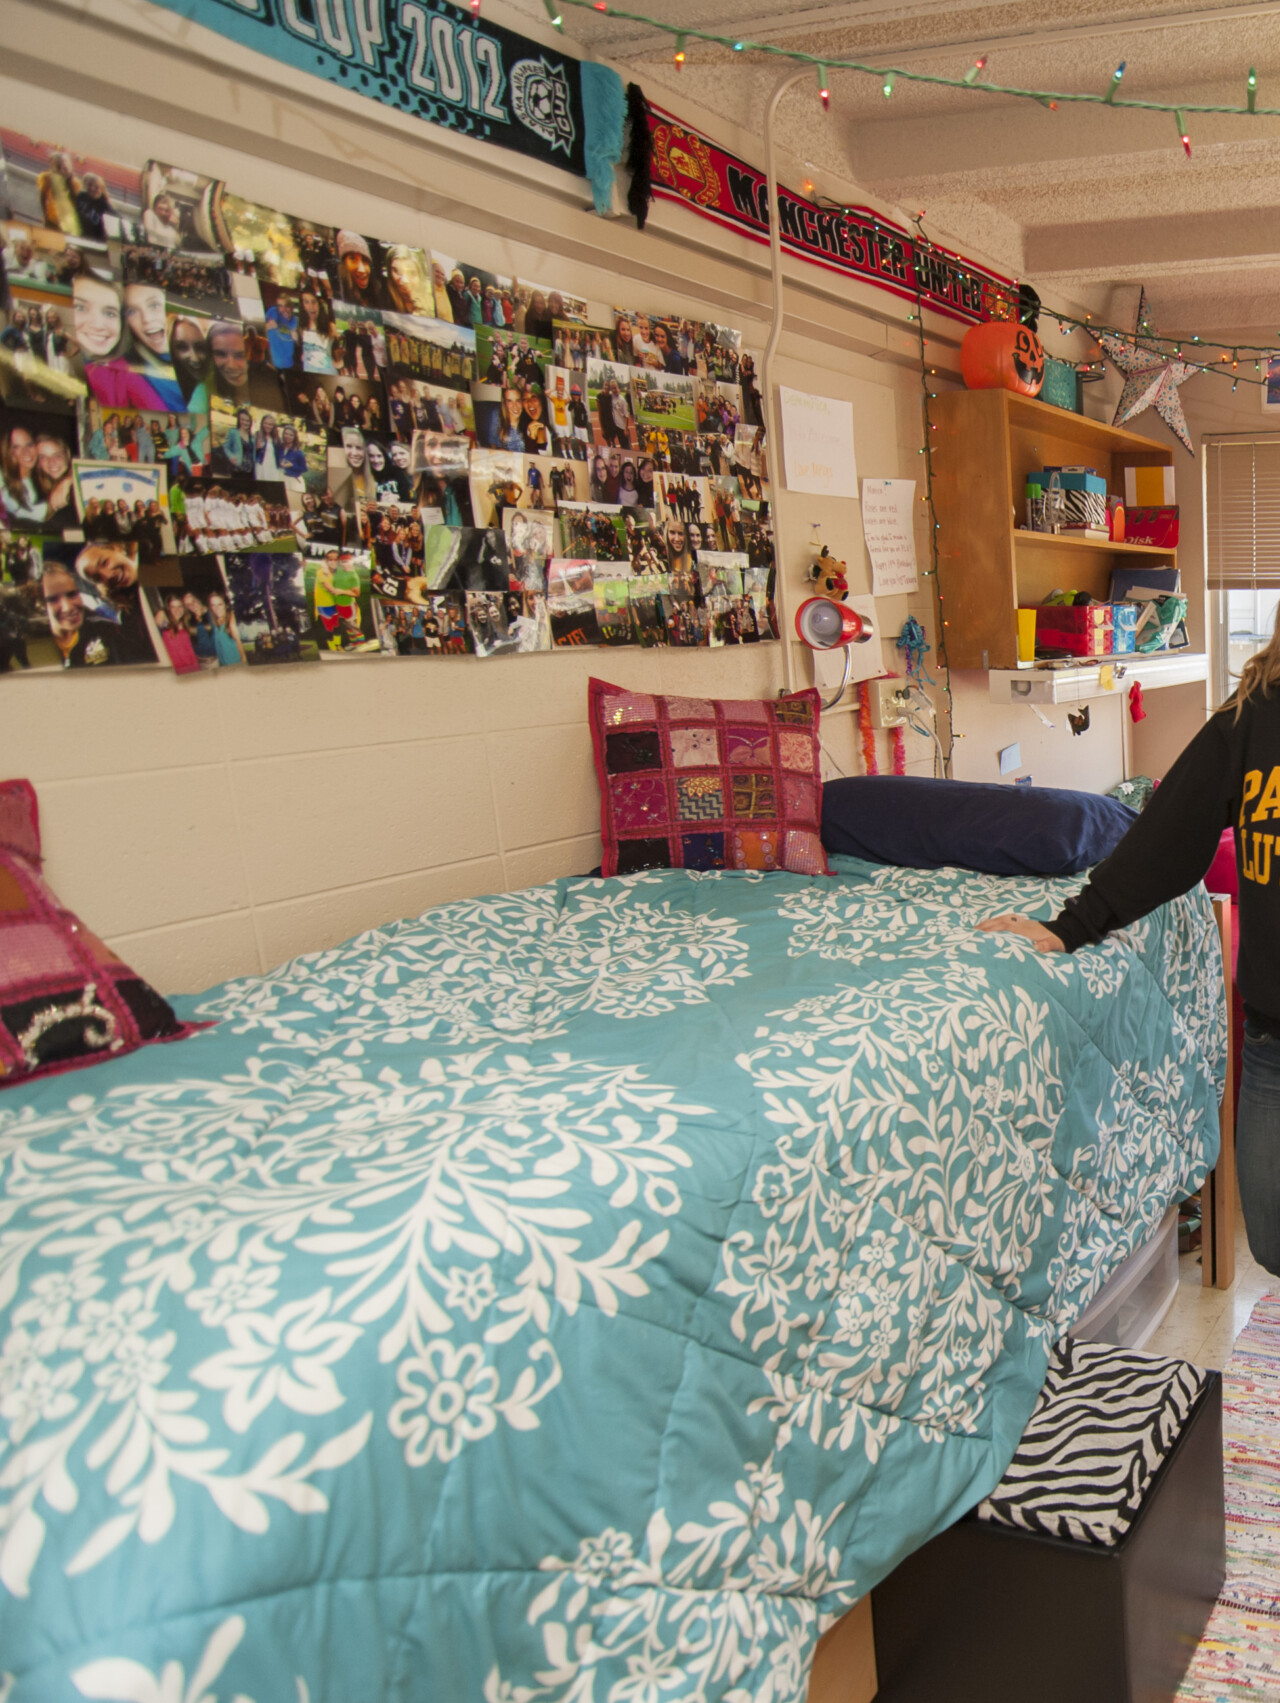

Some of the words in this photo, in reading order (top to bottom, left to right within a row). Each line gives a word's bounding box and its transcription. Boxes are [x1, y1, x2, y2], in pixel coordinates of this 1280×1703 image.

[402, 3, 505, 119] 2012
[554, 82, 571, 132] CUP
[913, 251, 982, 314] UNITED
